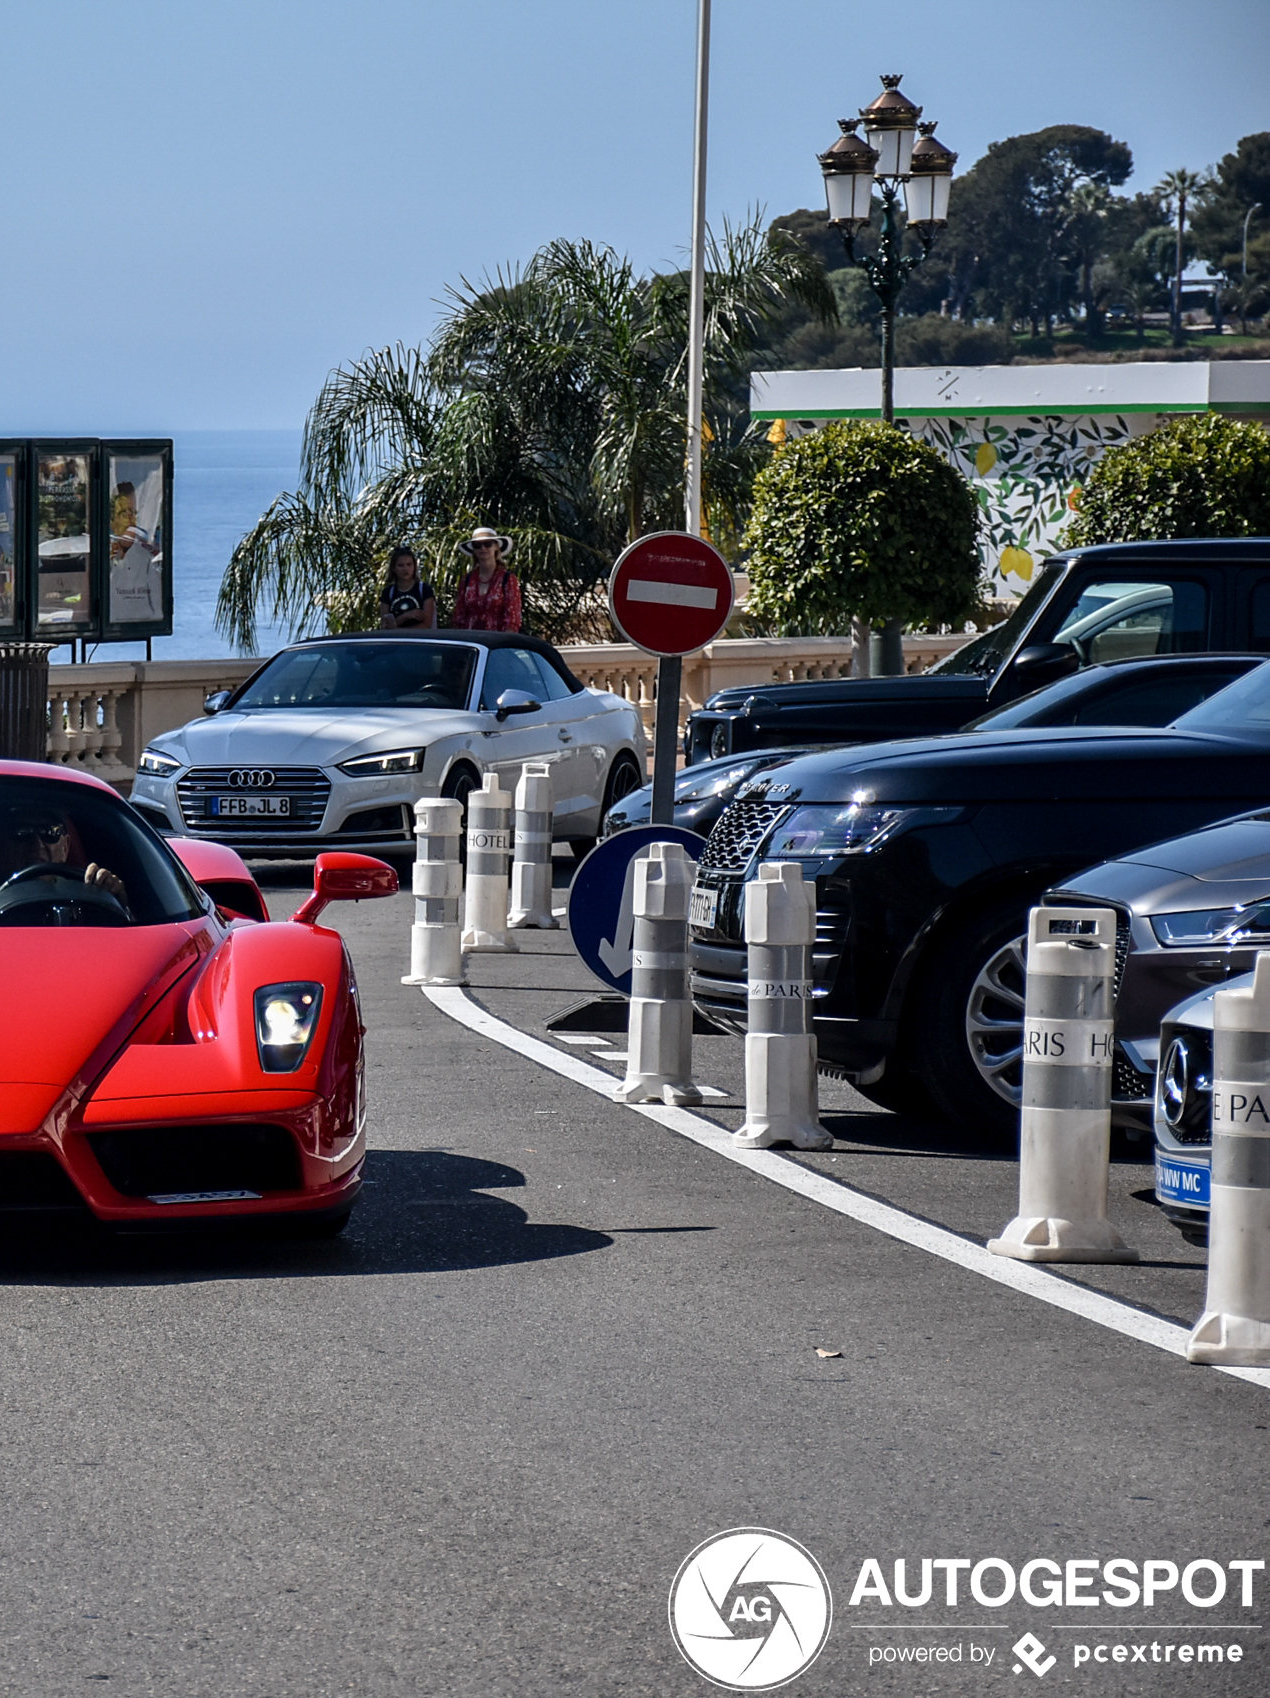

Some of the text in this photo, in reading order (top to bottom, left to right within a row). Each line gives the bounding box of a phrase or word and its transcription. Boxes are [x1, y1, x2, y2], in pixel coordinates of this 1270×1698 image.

[219, 798, 289, 814] FFB JL 8
[468, 833, 508, 849] HOTEL
[764, 983, 813, 999] PARIS
[1230, 1094, 1270, 1123] PA
[1182, 1171, 1201, 1193] MC
